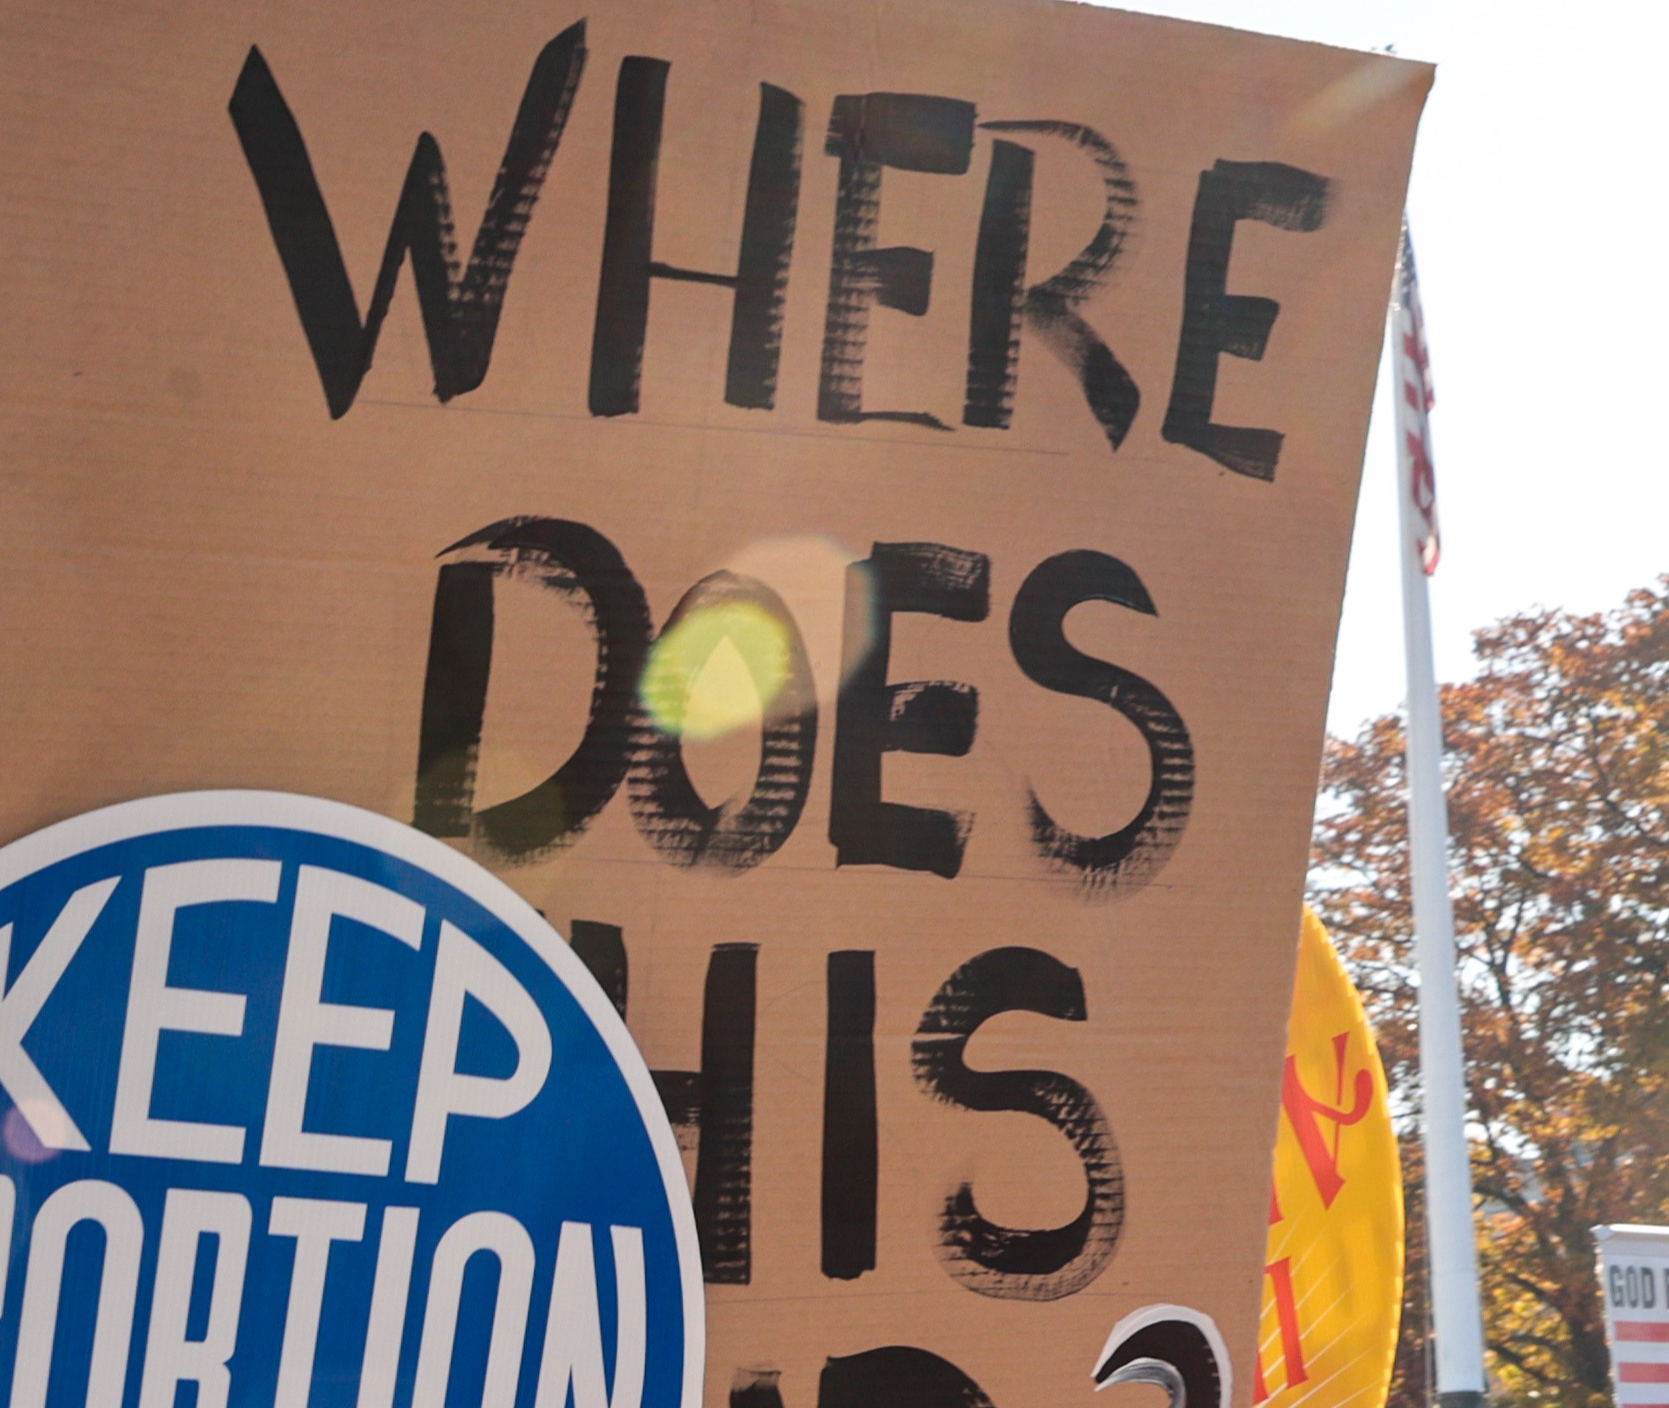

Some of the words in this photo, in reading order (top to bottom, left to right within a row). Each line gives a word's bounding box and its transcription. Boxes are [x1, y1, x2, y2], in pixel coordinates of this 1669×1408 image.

[228, 16, 1333, 483] WHERE
[411, 514, 1195, 905] DOES
[570, 920, 1126, 1302] HIS
[1609, 1264, 1659, 1309] GOD
